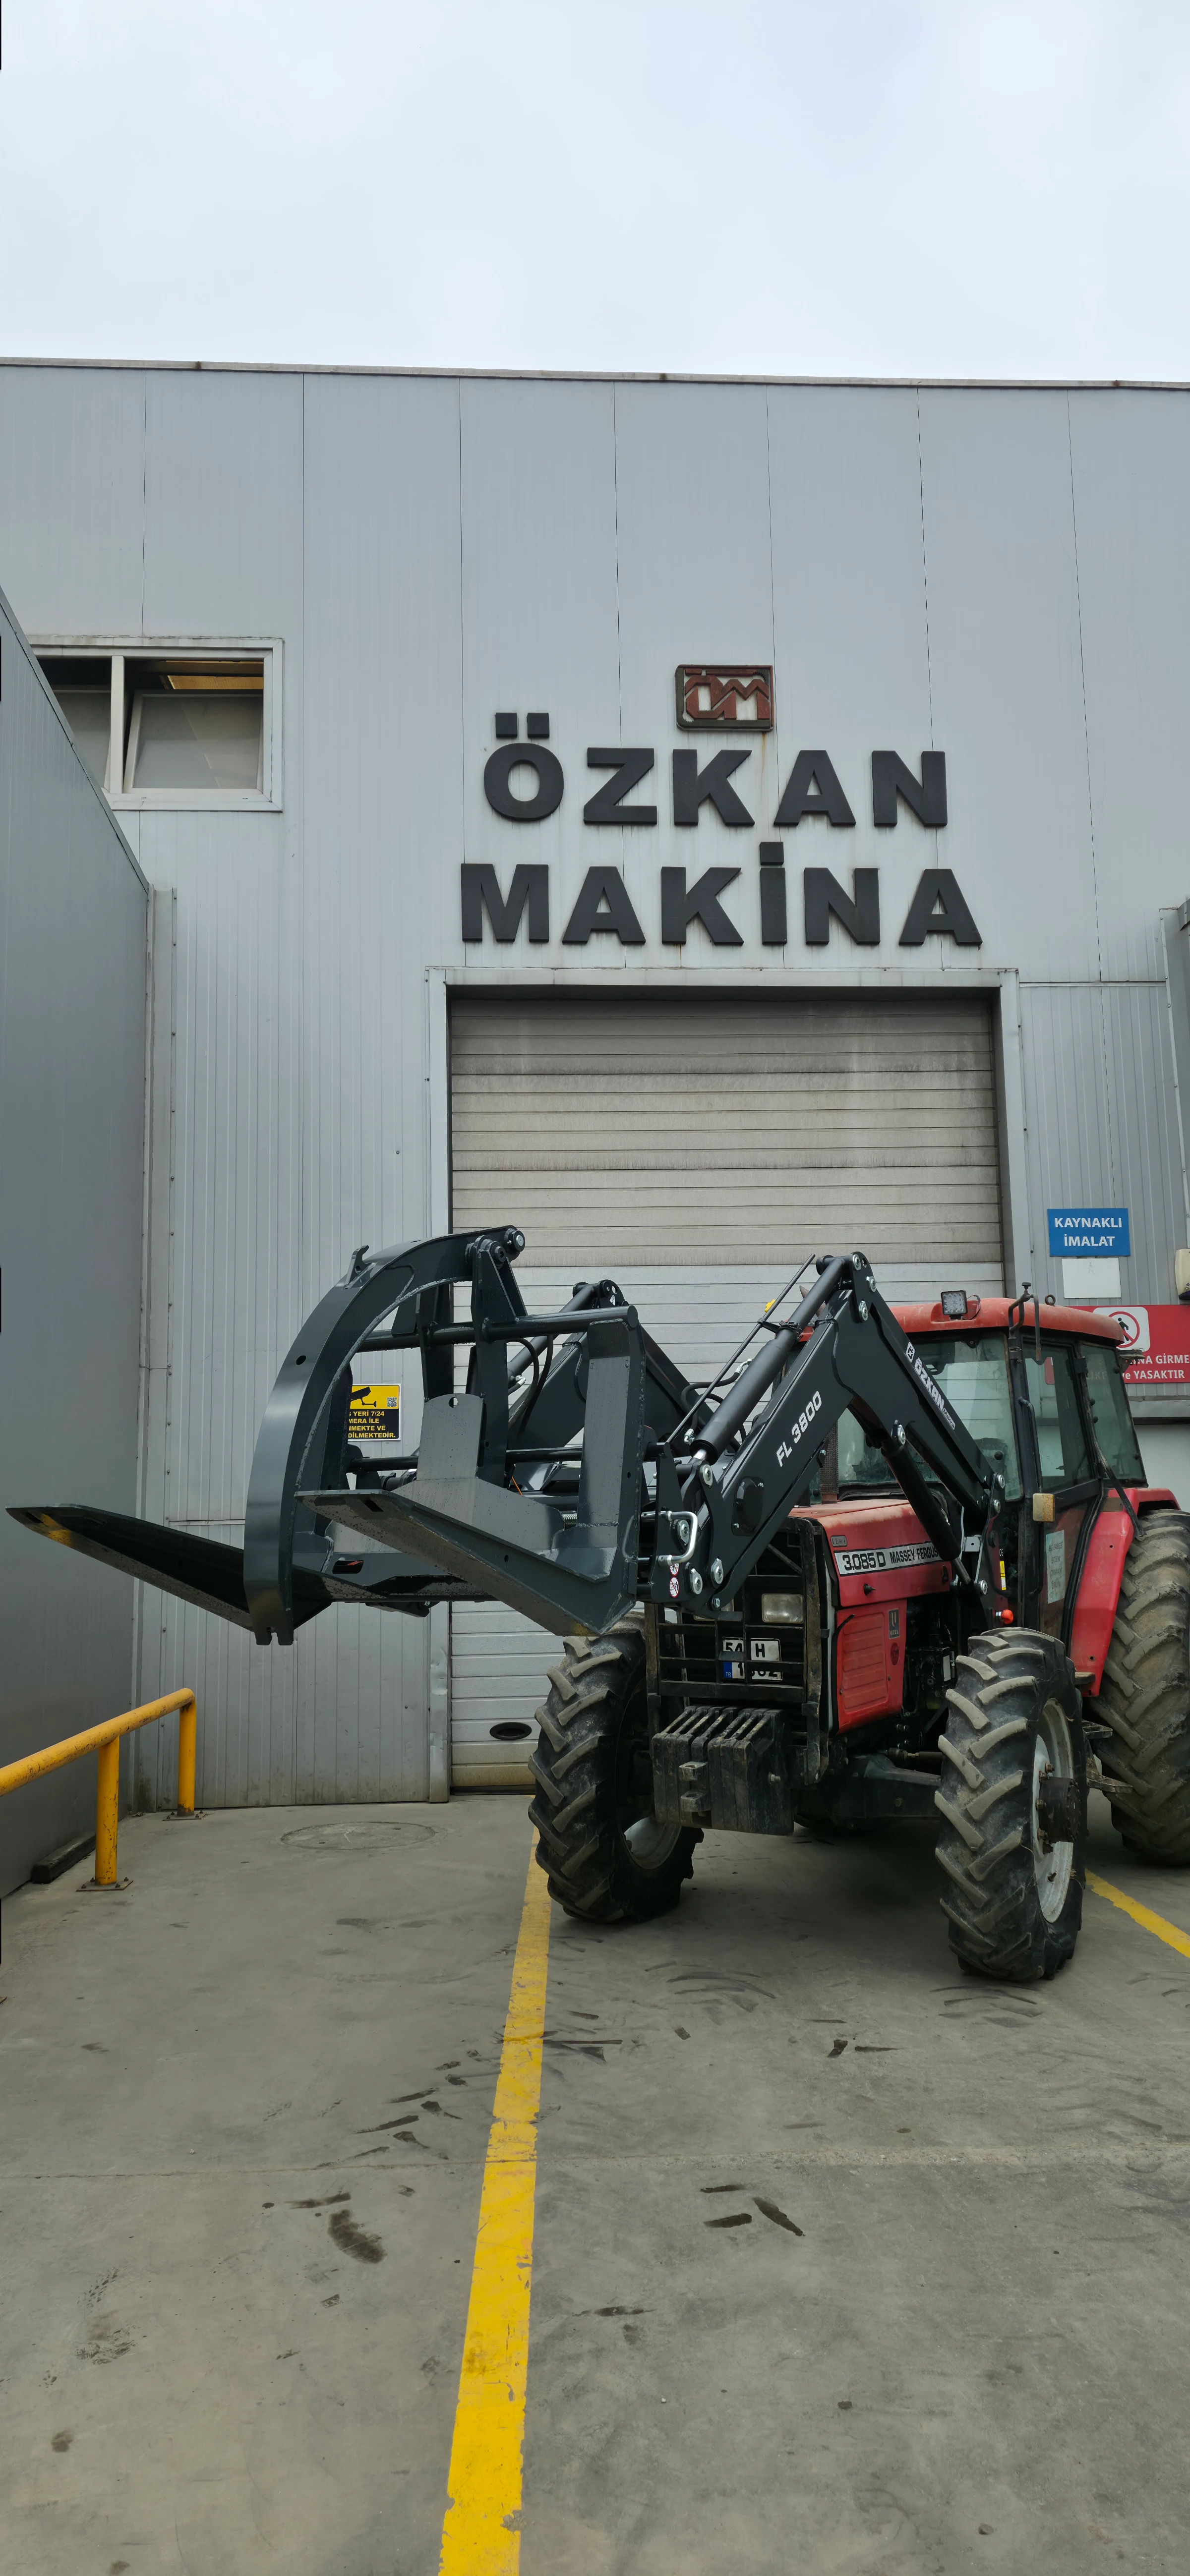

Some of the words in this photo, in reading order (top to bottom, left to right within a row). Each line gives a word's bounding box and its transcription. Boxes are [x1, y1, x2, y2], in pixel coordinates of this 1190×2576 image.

[484, 712, 948, 826] ÖZKAN
[461, 842, 983, 945] MAKİNA
[1055, 1217, 1122, 1228] KAYNAKLI
[1064, 1234, 1115, 1247] İMALAT
[1133, 1370, 1185, 1379] YASAKTIR
[914, 1357, 945, 1412] ÖZKAN
[776, 1441, 792, 1468] FL
[791, 1391, 822, 1443] 3800
[890, 1549, 916, 1564] MASSEY
[916, 1546, 939, 1560] FERGUS
[755, 1643, 766, 1658] H
